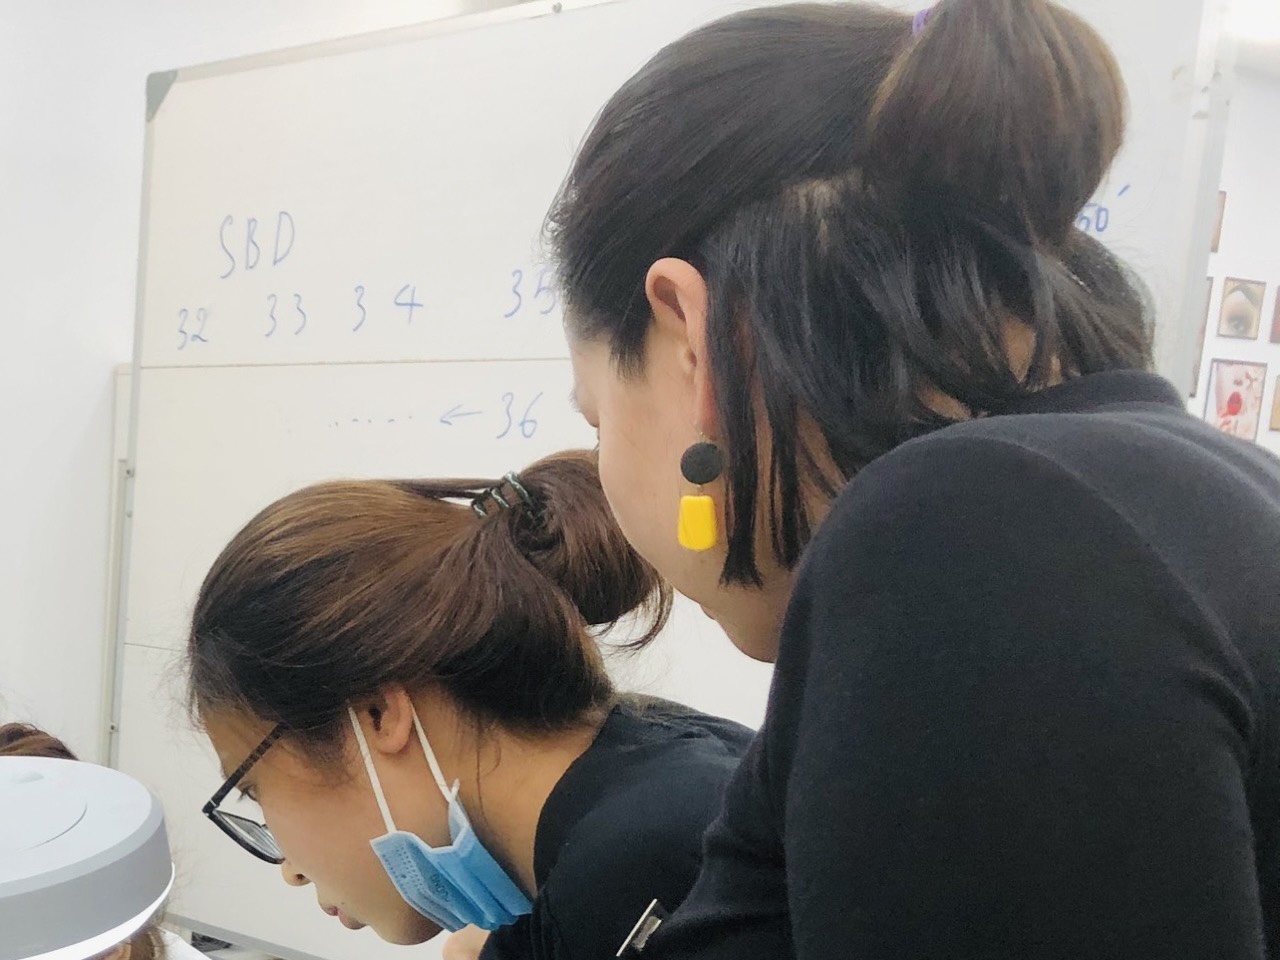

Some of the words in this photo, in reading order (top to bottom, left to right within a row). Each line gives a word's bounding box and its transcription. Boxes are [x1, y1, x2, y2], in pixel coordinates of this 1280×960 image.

[220, 211, 294, 279] SBD
[177, 308, 209, 350] 32
[265, 294, 307, 337] 33
[353, 284, 424, 331] 34
[504, 267, 558, 318] 35
[496, 391, 543, 439] 36
